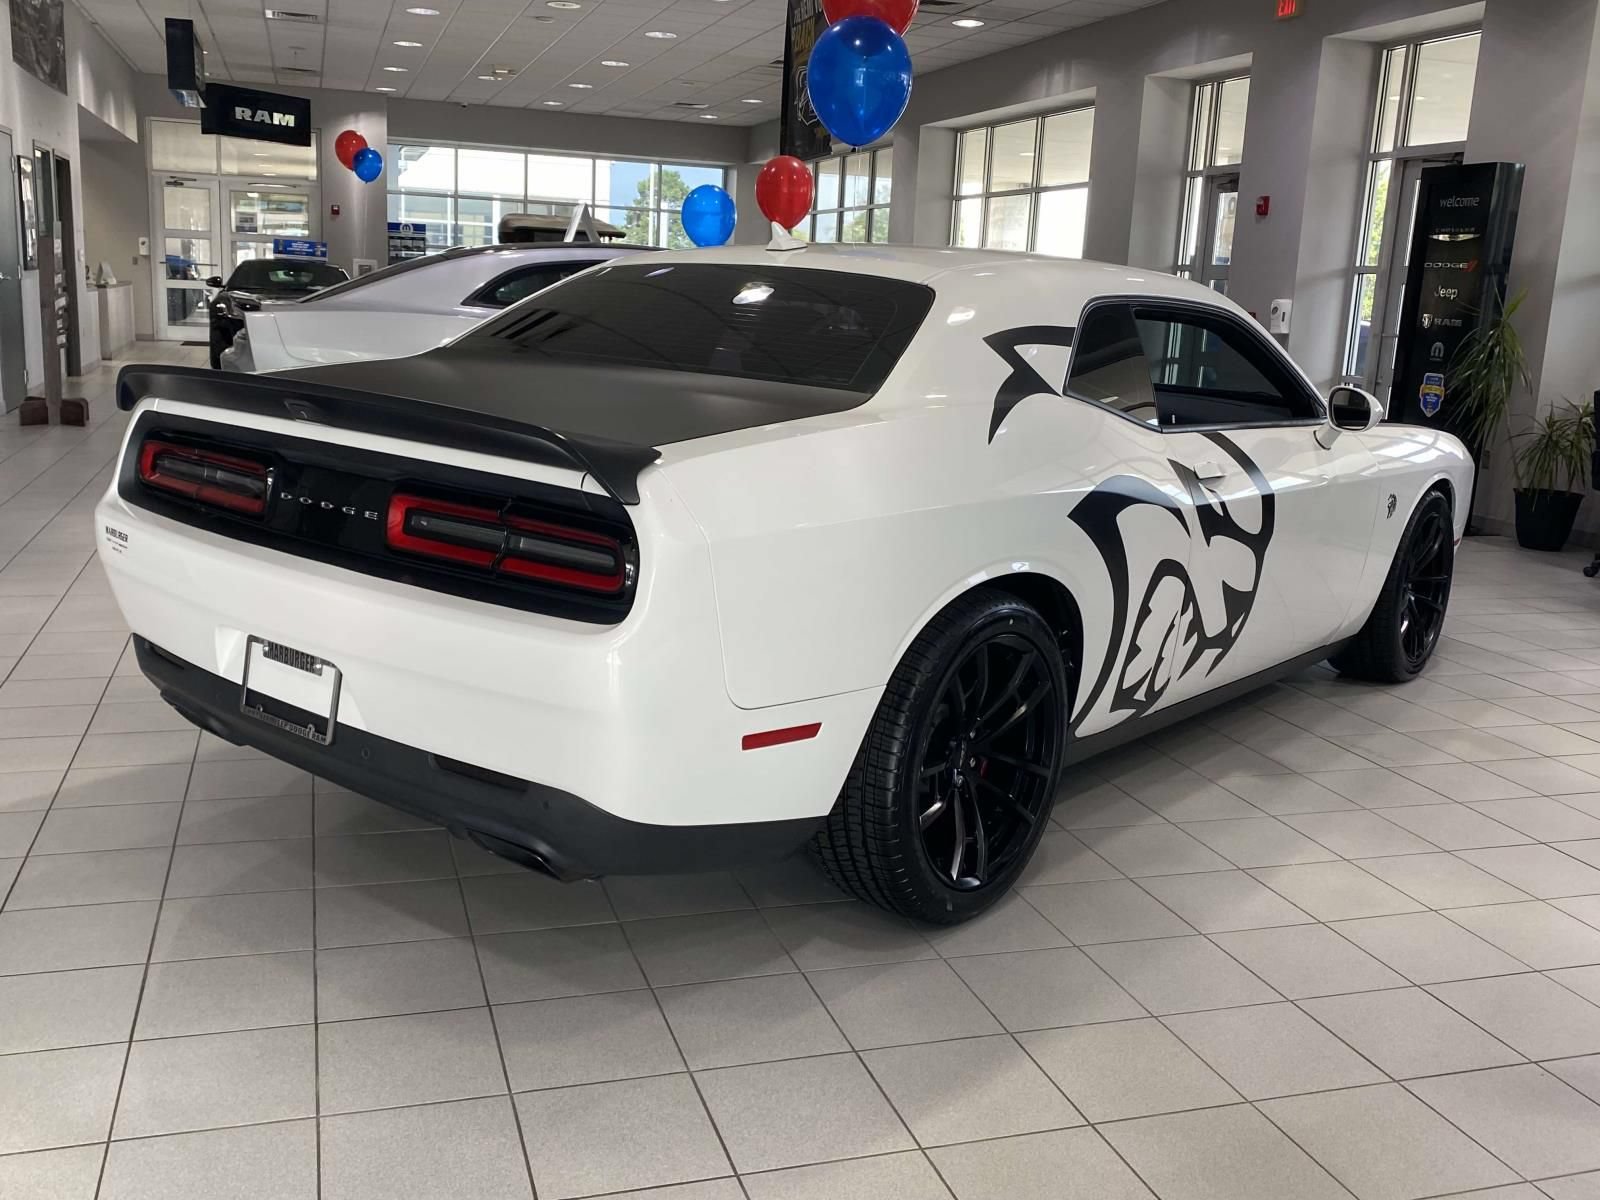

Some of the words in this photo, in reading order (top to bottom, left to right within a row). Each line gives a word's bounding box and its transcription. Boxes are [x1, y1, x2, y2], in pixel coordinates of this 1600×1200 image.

[234, 106, 295, 127] RAM
[1440, 195, 1480, 208] welcome
[1434, 284, 1458, 300] Jeep
[280, 491, 379, 521] DODGE
[267, 640, 316, 674] MARBURGER
